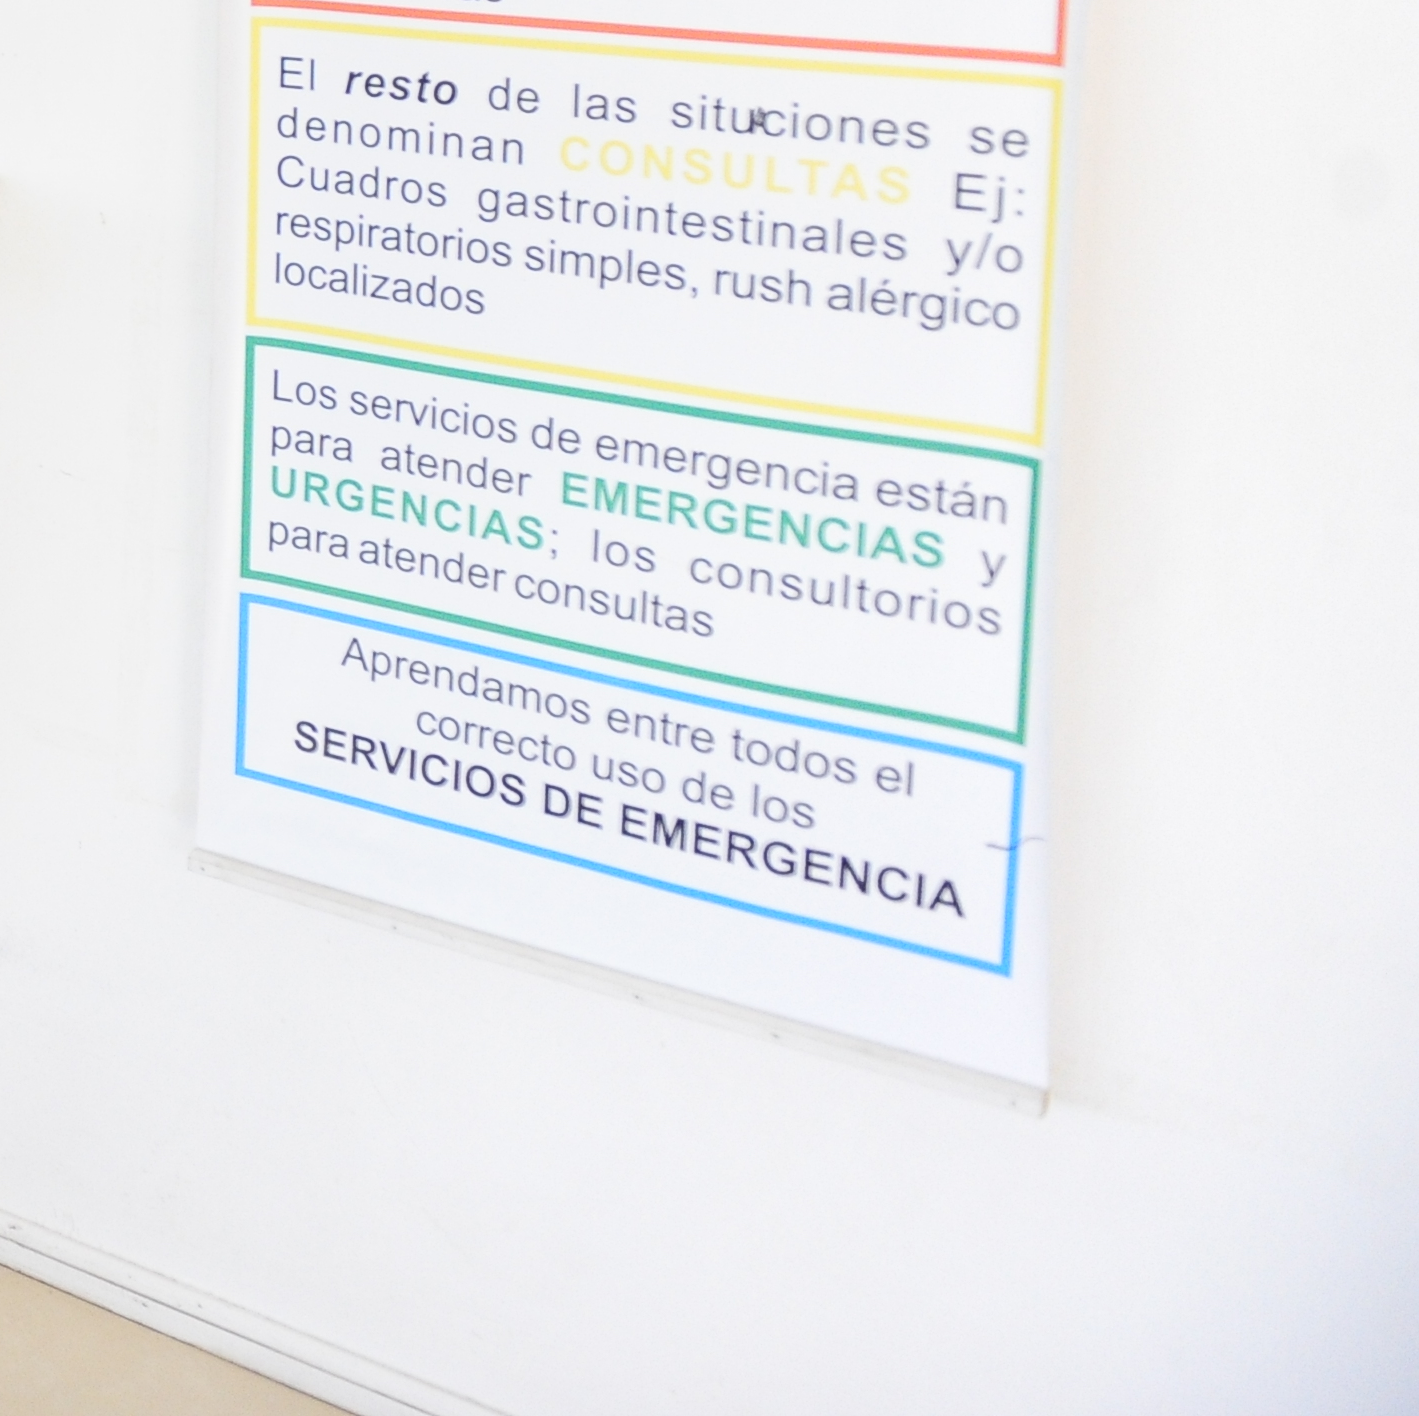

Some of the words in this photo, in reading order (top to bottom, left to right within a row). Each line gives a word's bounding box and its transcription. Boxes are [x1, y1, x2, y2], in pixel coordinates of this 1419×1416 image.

[276, 109, 525, 166] denominan
[558, 135, 912, 205] CONSULTAS
[952, 170, 1026, 224] Ej:
[278, 56, 317, 93] El
[344, 68, 459, 107] resto
[487, 77, 541, 116] de
[572, 84, 638, 126] las
[968, 123, 1030, 159] se
[274, 209, 513, 270] respiratorios
[524, 239, 699, 297] simples,
[713, 262, 812, 308] rush
[826, 276, 1021, 333] alérgico
[276, 155, 447, 209] Cuadros
[477, 181, 909, 262] gastrointestinales
[945, 235, 1025, 278] y/o
[274, 253, 486, 316] localizados
[270, 422, 354, 464] para
[379, 440, 531, 498] atender
[560, 471, 946, 570] EMERGENCIAS
[980, 547, 1008, 588] y
[271, 369, 338, 411] Los
[348, 391, 519, 446] servicios
[530, 417, 583, 457] de
[594, 435, 858, 502] emergencia
[875, 477, 1009, 524] están
[268, 516, 350, 560] para
[359, 535, 506, 594] atender
[514, 570, 715, 639] consultas
[270, 466, 561, 560] URGENCIAS;
[590, 529, 657, 574] los
[688, 552, 1003, 637] consultorios
[340, 636, 591, 726] Aprendamos
[606, 707, 715, 755] entre
[732, 727, 857, 789] todos
[875, 758, 916, 797] el
[414, 707, 577, 773] correcto
[590, 754, 666, 795] uso
[680, 768, 735, 811] de
[751, 784, 816, 830] los
[293, 719, 527, 808] SERVICIOS
[542, 783, 603, 830] DE
[619, 805, 966, 919] EMERGENCIA
